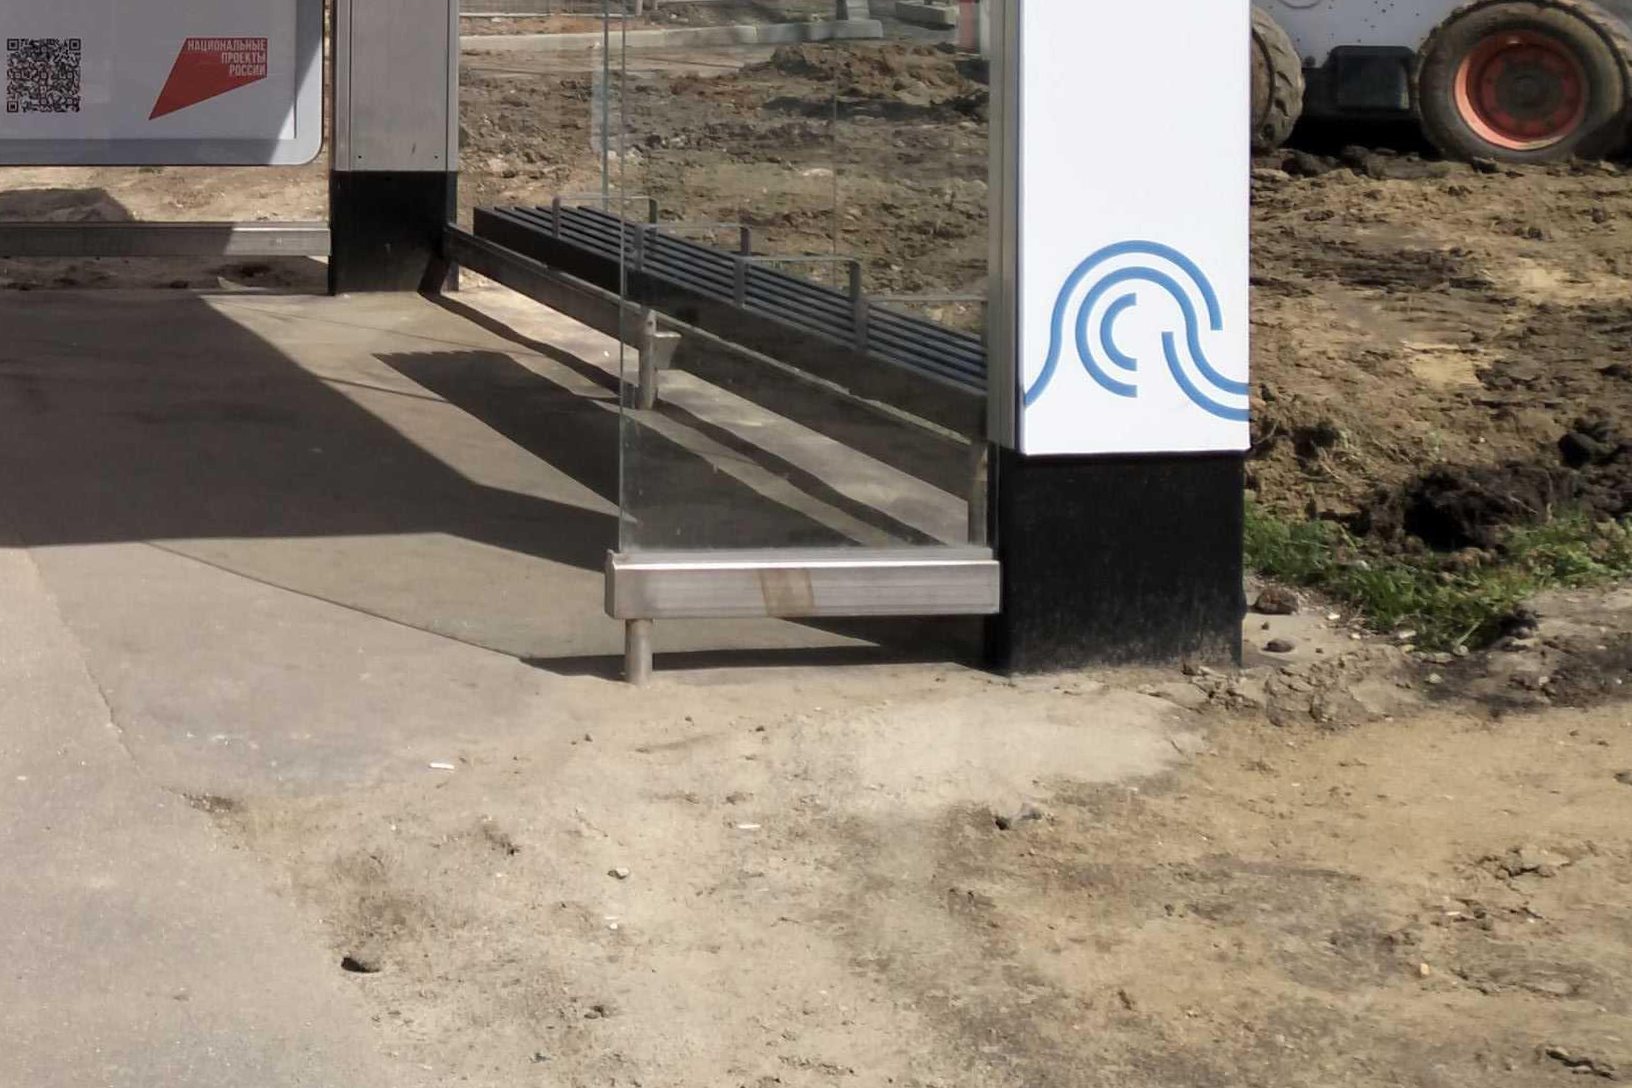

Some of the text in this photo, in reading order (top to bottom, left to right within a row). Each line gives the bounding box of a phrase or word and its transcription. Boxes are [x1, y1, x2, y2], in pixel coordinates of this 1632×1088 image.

[187, 39, 266, 52] НАЦИОНАЛЬНЫЕ
[221, 52, 266, 64] ПРОЕКТЫ
[229, 64, 266, 76] РОССИИ
